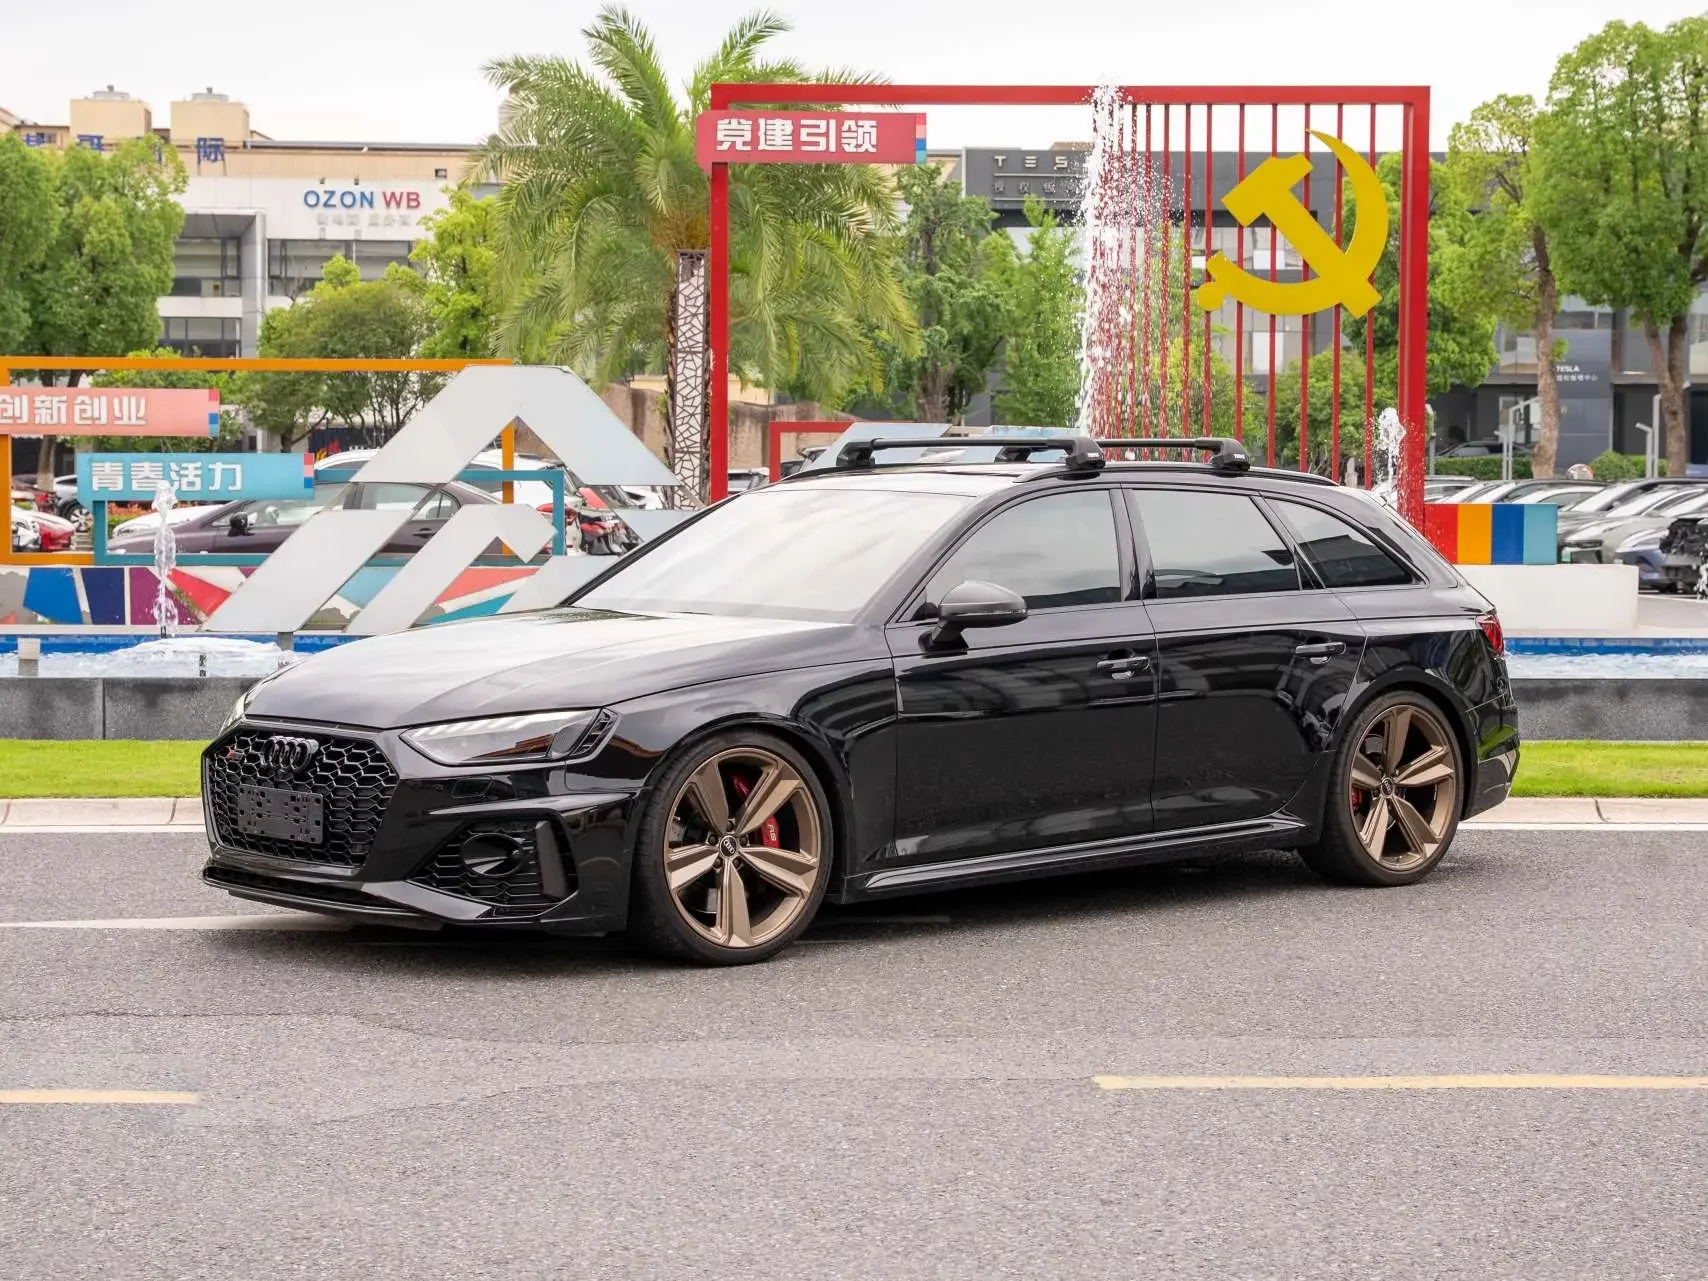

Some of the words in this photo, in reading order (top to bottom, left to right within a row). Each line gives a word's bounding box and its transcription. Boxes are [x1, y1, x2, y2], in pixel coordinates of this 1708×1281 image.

[716, 118, 877, 152] 党建引领
[304, 190, 374, 209] OZON
[382, 191, 421, 210] WB
[0, 394, 146, 425] 创新创业
[92, 461, 242, 491] 青春活力
